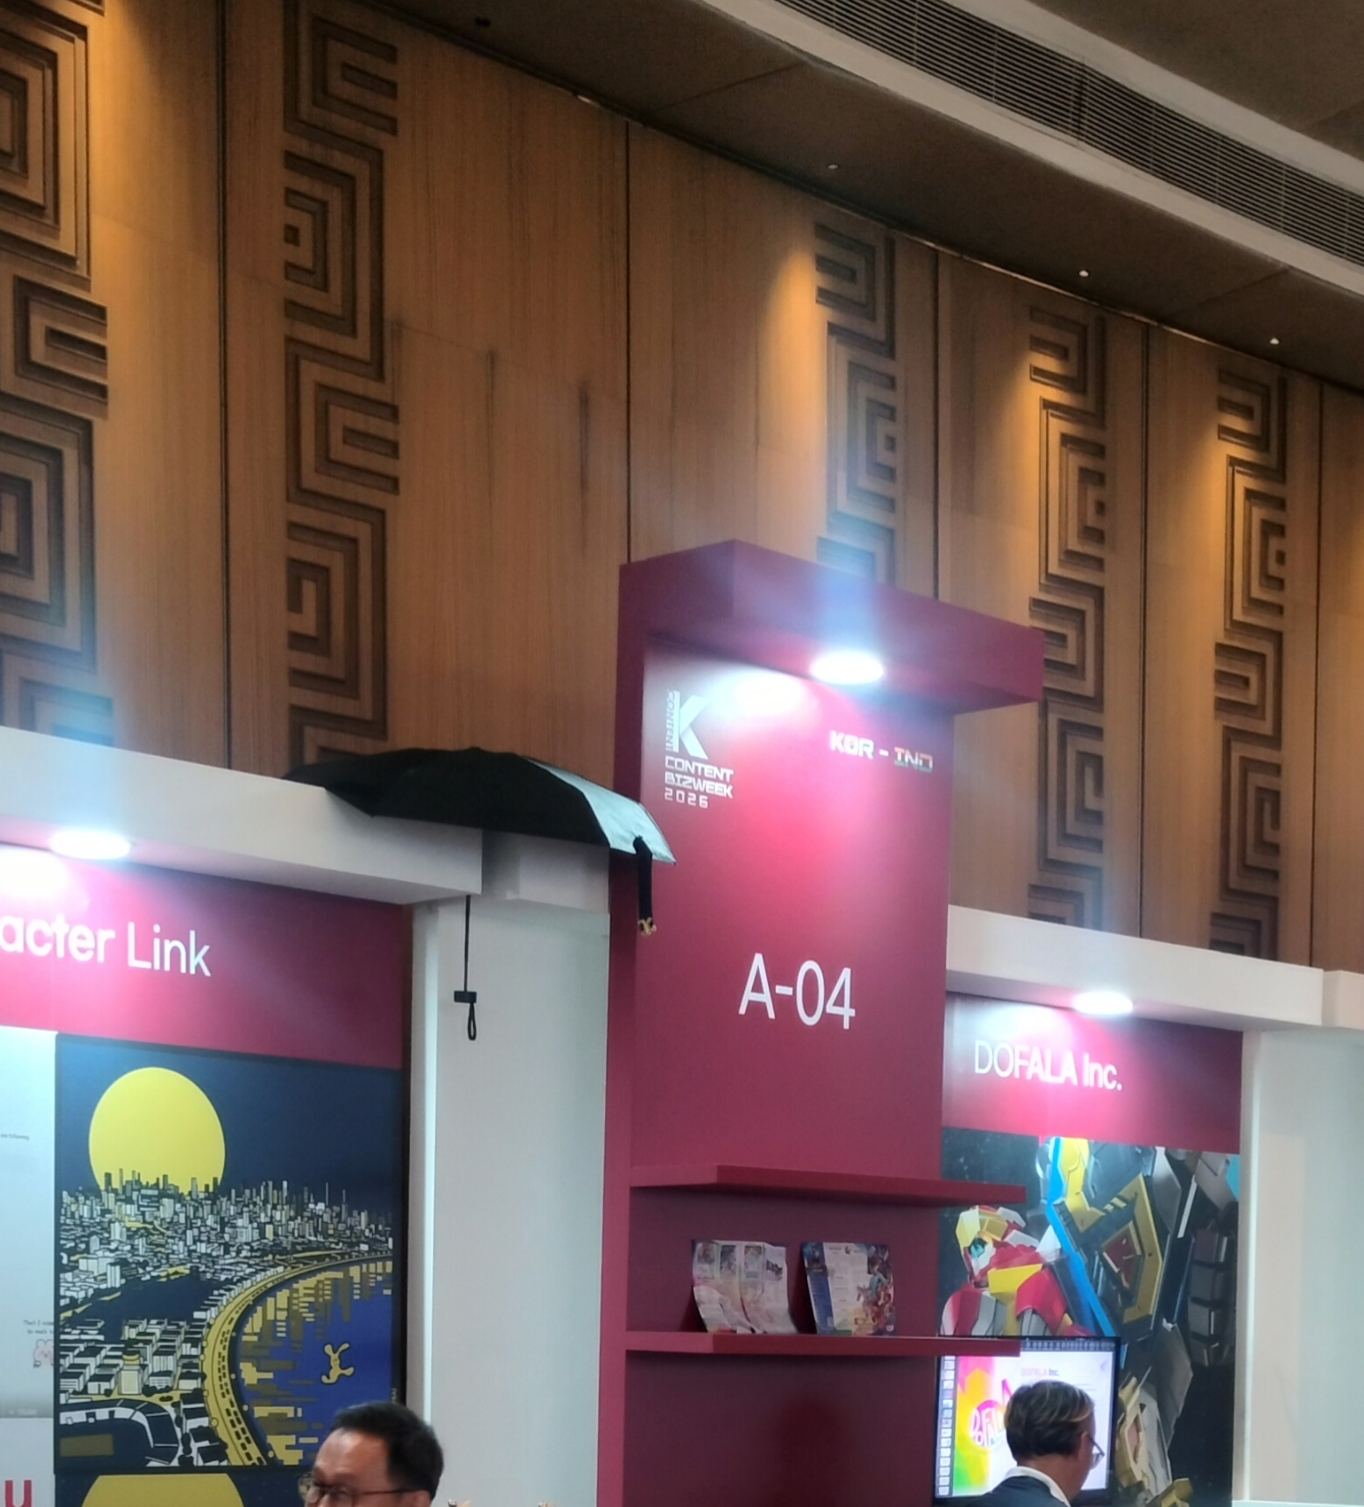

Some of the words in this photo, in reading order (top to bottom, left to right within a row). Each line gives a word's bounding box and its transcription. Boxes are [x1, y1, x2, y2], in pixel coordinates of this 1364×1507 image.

[665, 755, 734, 783] CONTENT
[829, 730, 874, 759] KOR
[894, 746, 934, 774] IND
[664, 771, 734, 799] BIZWEEK
[664, 787, 708, 809] 2026
[127, 921, 212, 977] Link
[738, 952, 856, 1030] A-04
[974, 1040, 1078, 1086] DOFALA
[1082, 1052, 1123, 1091] Inc.
